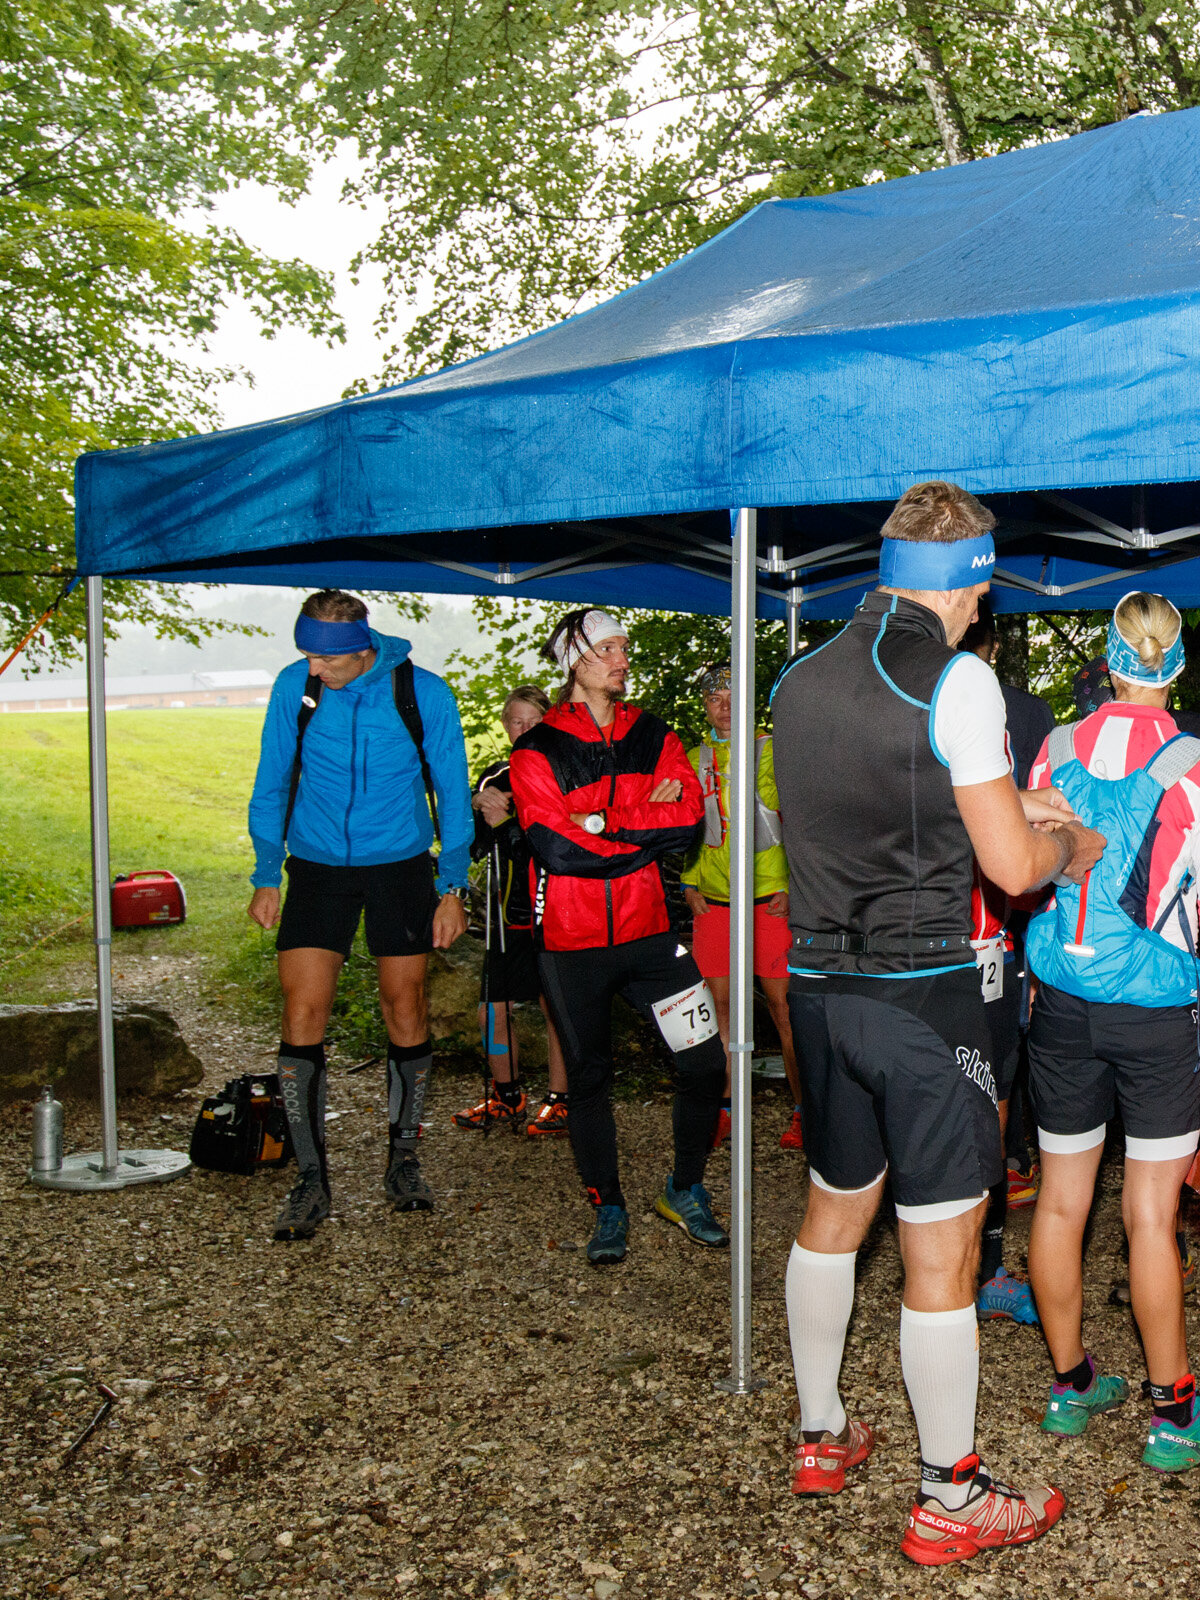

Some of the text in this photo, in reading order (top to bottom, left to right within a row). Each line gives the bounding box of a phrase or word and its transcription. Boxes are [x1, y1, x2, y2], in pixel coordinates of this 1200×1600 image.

[682, 1002, 711, 1029] 75
[282, 1081, 301, 1124] SOCKS
[1159, 1432, 1197, 1448] salomon
[918, 1511, 967, 1534] salomon
